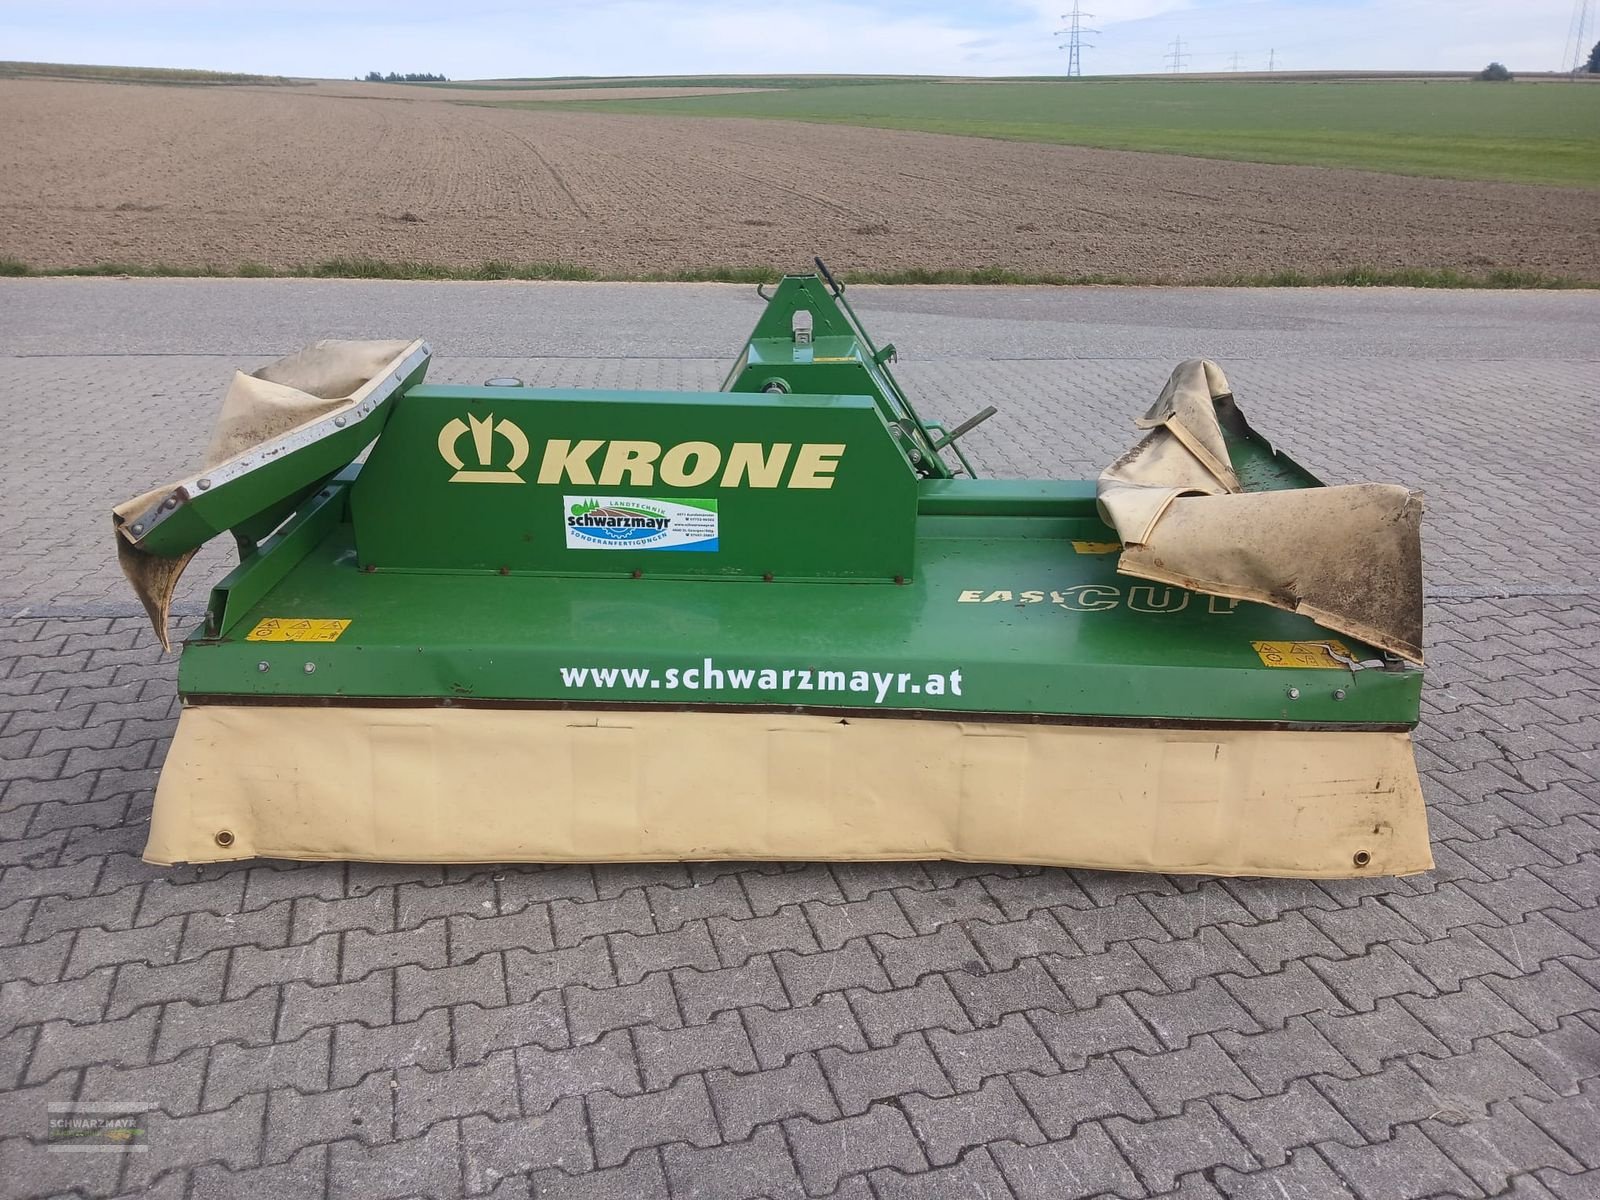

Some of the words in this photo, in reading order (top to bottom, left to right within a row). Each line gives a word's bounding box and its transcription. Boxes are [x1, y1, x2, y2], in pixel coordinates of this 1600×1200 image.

[537, 439, 846, 489] KRONE
[609, 500, 666, 514] LANDTECHNIK
[568, 513, 671, 530] schwarzmayr
[570, 530, 668, 546] SONDERANFERTIGUNGEN
[560, 657, 962, 704] www.schwarzmayr.at
